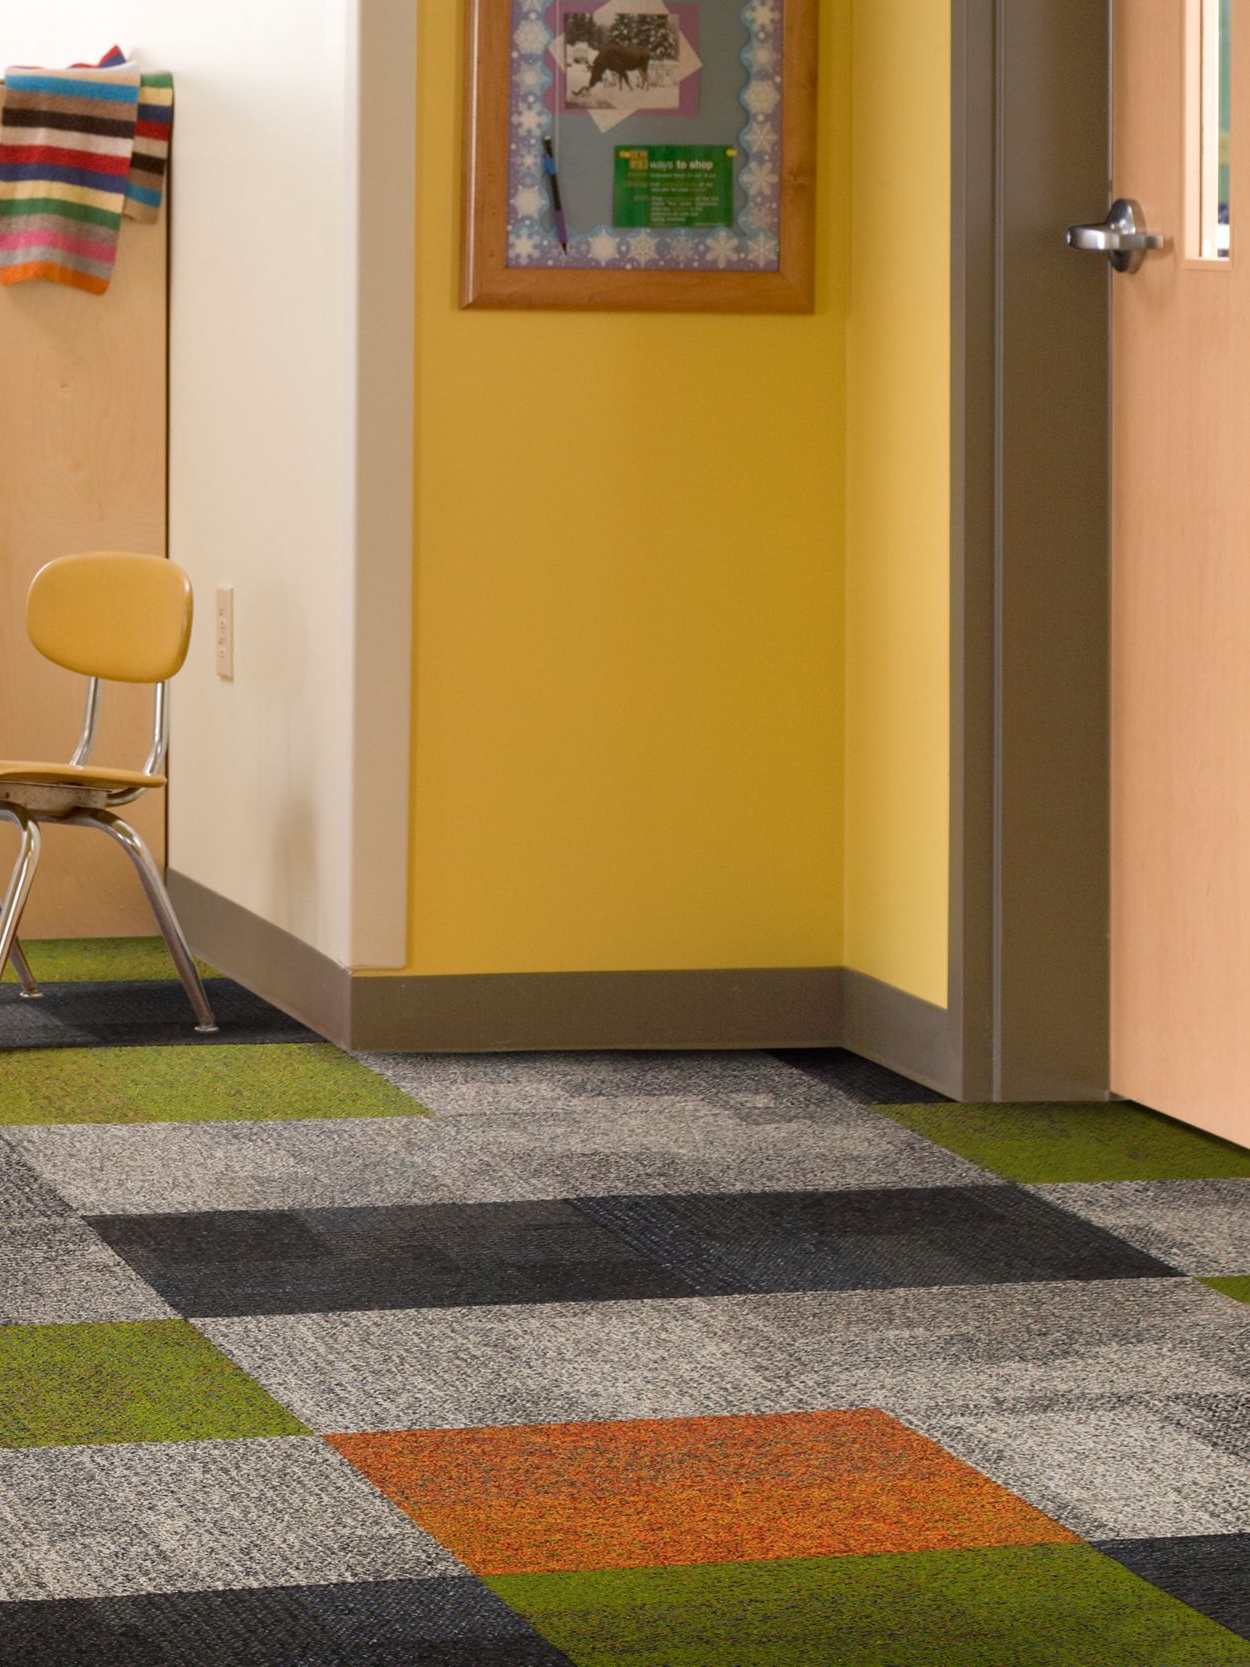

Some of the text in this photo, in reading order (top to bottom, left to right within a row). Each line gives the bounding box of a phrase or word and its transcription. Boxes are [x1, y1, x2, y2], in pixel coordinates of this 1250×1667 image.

[650, 160, 713, 171] ways to shop
